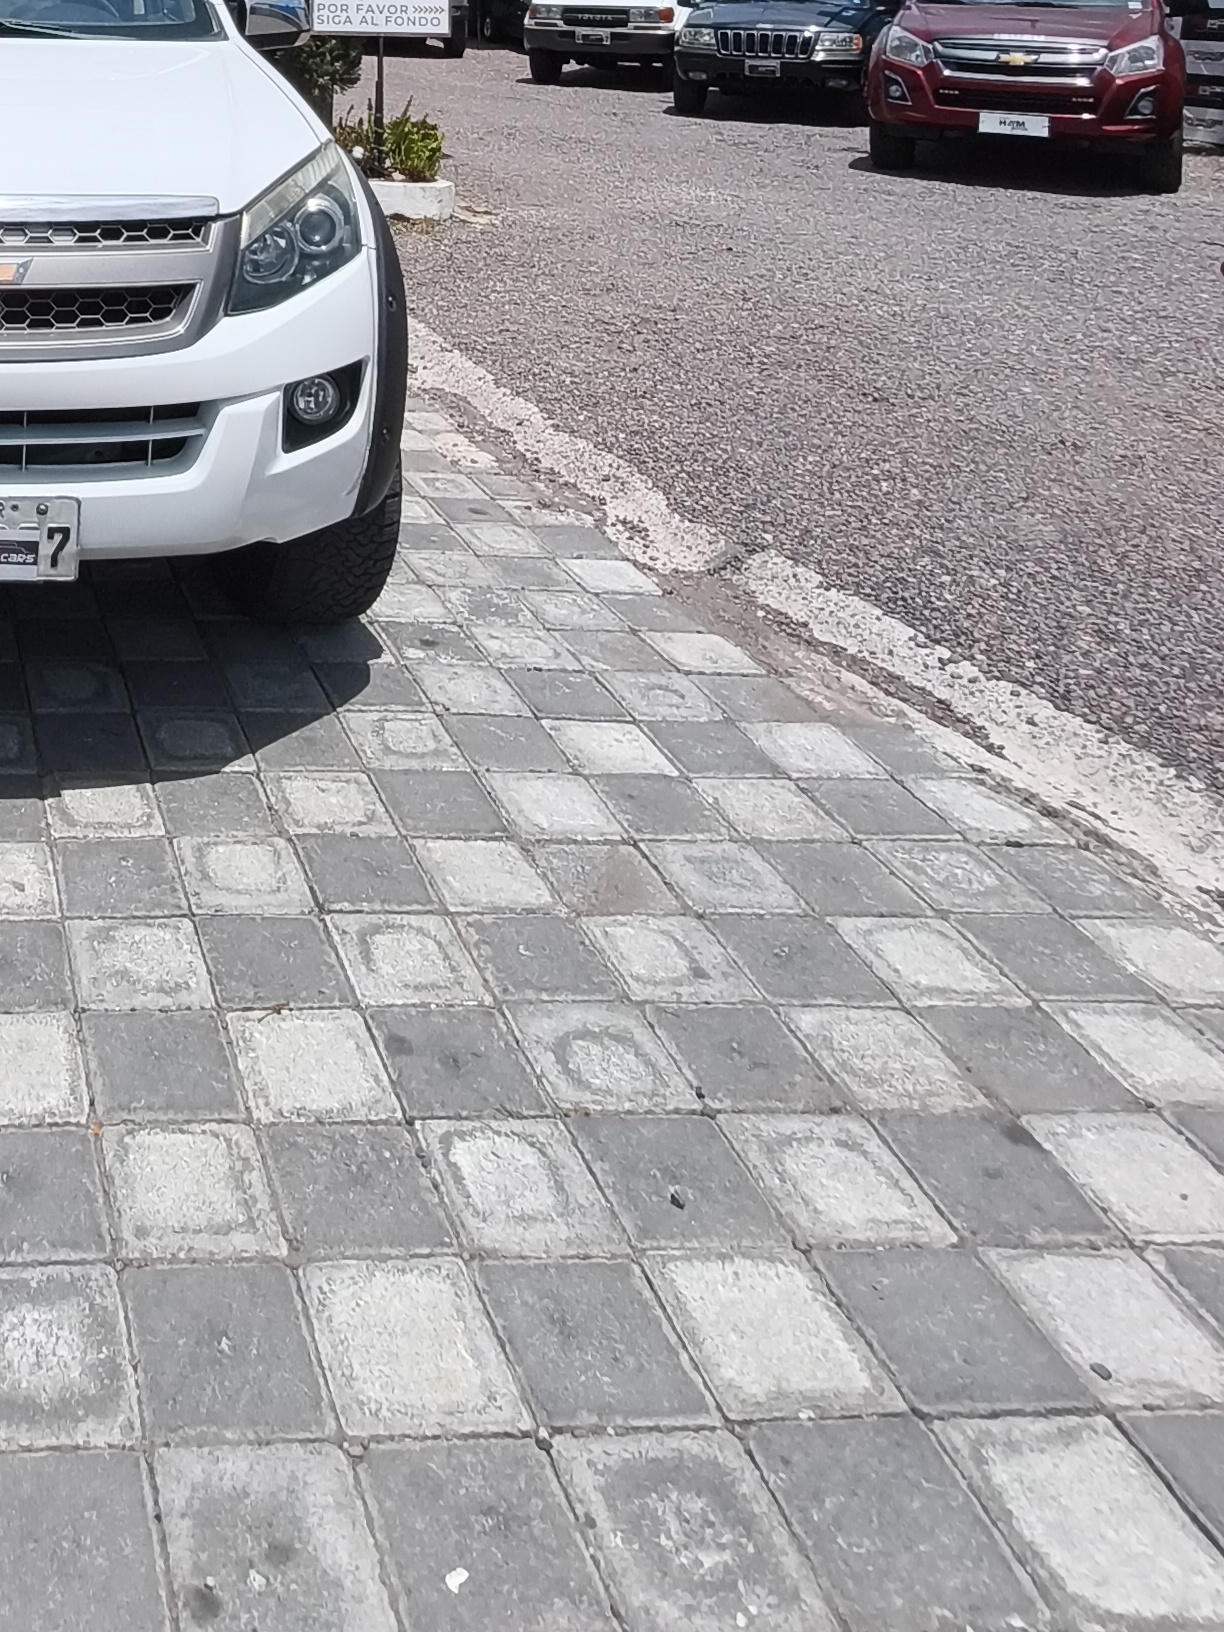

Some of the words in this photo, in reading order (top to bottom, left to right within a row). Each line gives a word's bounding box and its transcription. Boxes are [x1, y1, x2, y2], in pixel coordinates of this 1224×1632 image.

[317, 3, 349, 14] POR
[356, 4, 409, 15] FAVOR
[316, 14, 353, 26] SIGA
[359, 15, 379, 26] AL
[385, 15, 441, 27] FONDO
